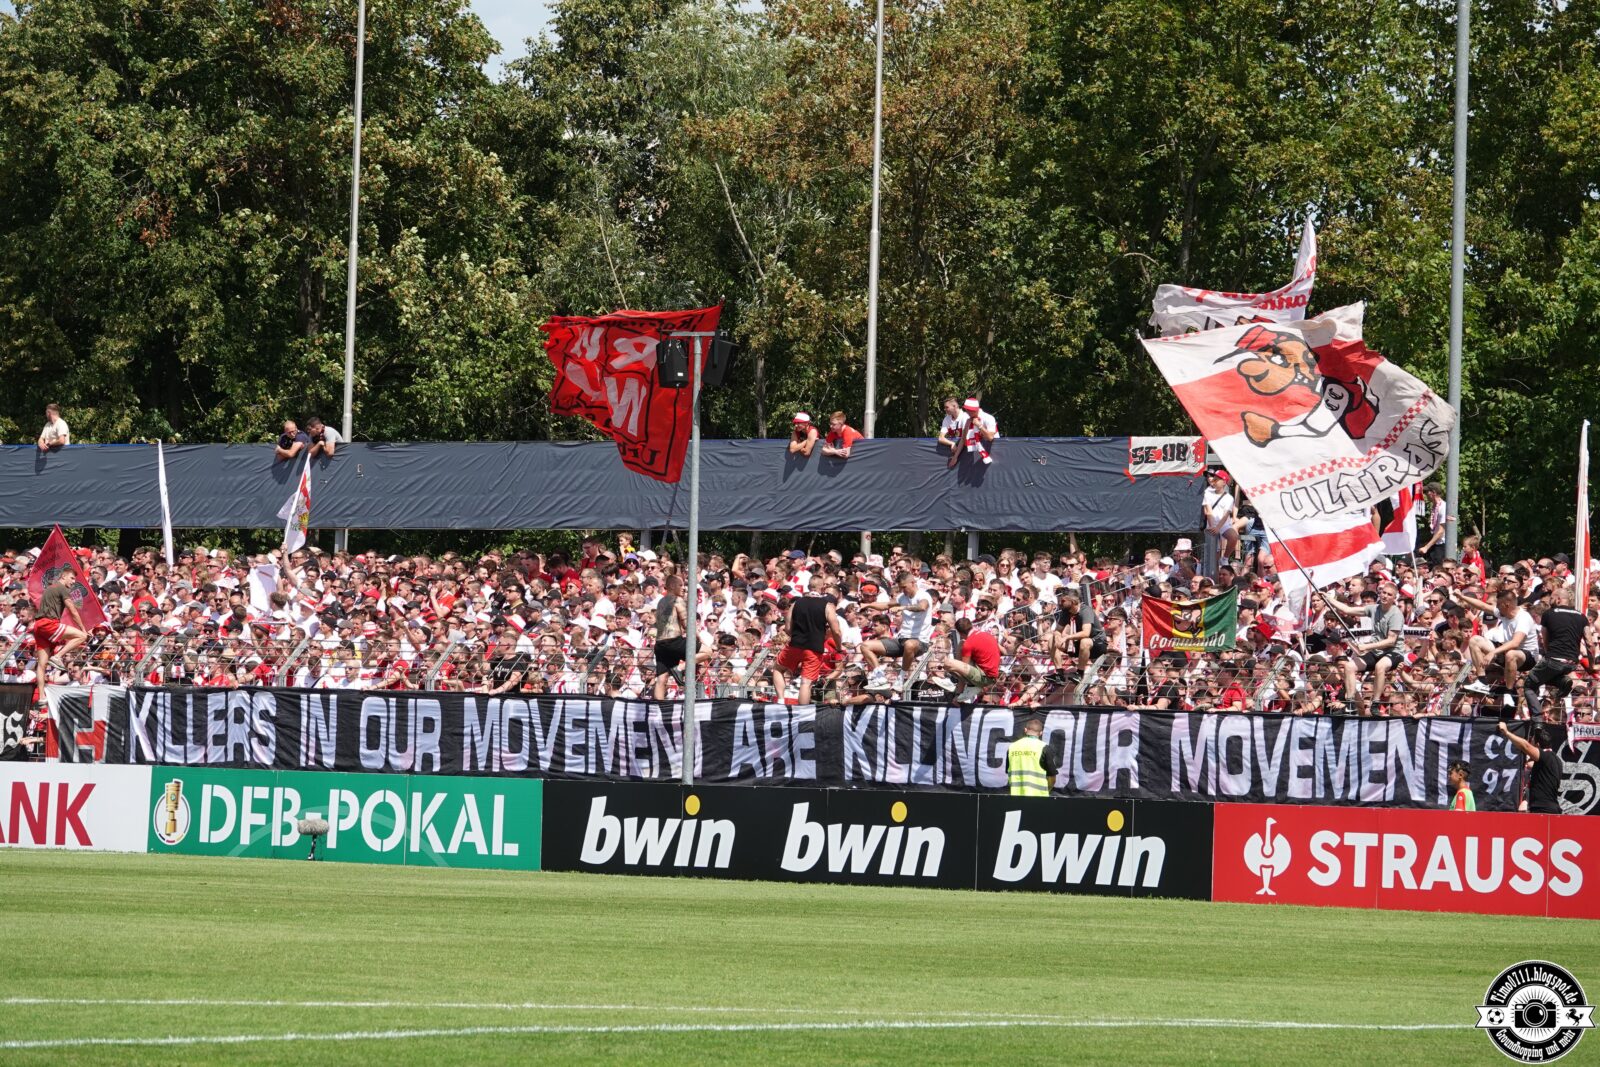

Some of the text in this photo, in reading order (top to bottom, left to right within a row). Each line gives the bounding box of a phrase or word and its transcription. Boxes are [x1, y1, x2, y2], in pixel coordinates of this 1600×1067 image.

[1280, 418, 1449, 520] ULTRAS
[129, 689, 278, 765] KILLERS
[300, 693, 338, 769] IN
[359, 696, 441, 772] OUR
[462, 696, 712, 779] MOVEMENT
[728, 702, 817, 780] ARE
[843, 704, 1014, 788] KILLING
[1042, 709, 1140, 792] OUR
[0, 782, 96, 846] NK
[1482, 768, 1519, 795] 97
[199, 783, 519, 857] DFB-POKAL
[580, 795, 736, 869] bwin
[780, 801, 945, 877] bwin
[992, 809, 1166, 888] bwin
[1306, 830, 1584, 897] STRAUSS
